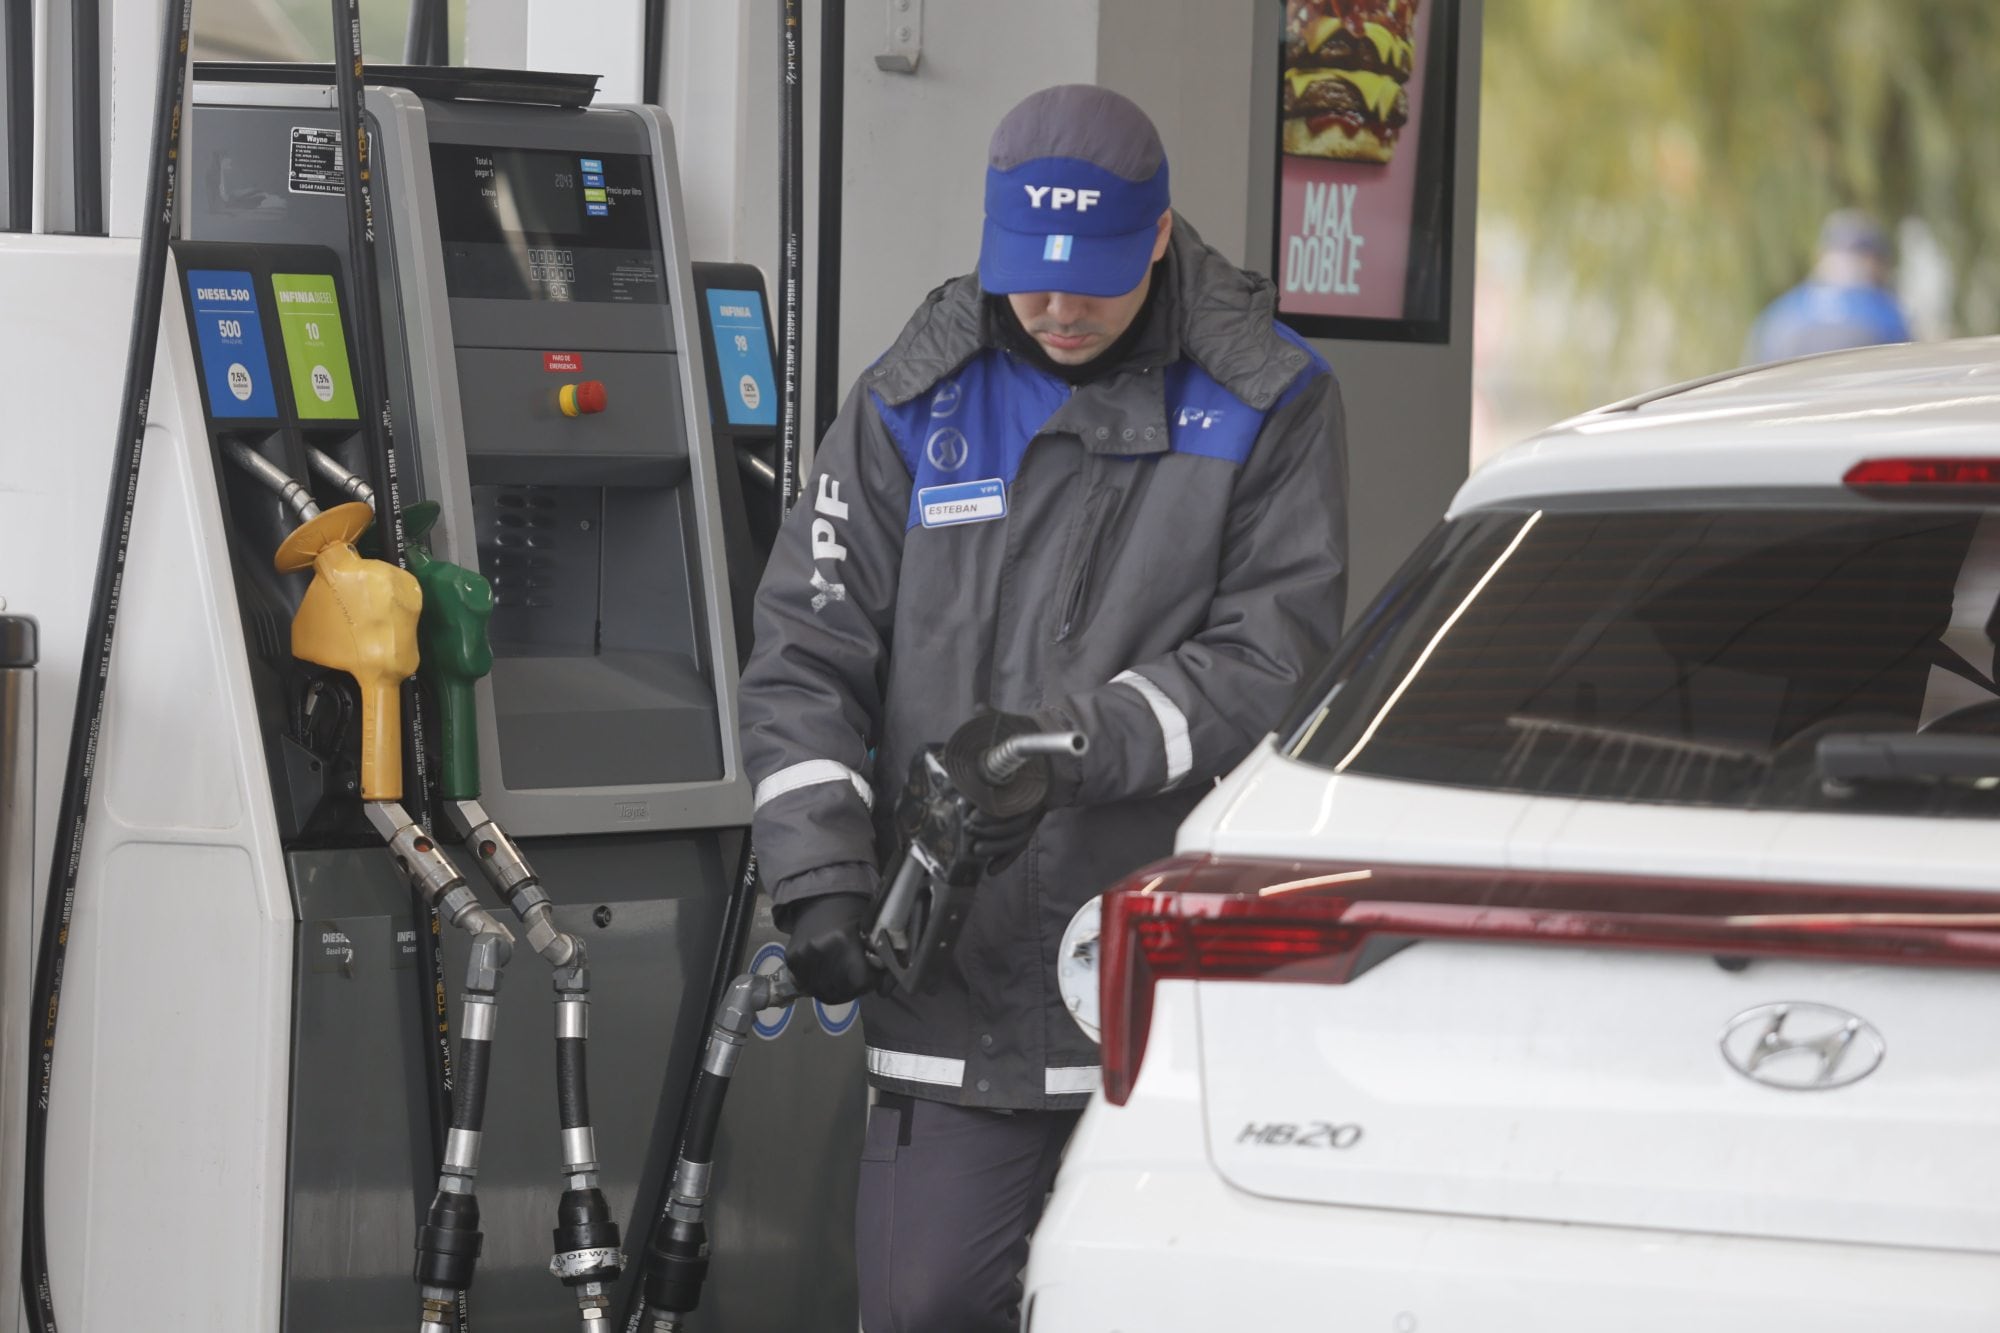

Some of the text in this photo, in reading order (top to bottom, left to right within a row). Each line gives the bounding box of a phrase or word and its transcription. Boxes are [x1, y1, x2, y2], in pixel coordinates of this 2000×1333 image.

[307, 135, 328, 144] Wayne
[1024, 184, 1101, 212] YPF
[1304, 181, 1357, 238] MAX
[1286, 235, 1364, 295] DOBLE
[218, 320, 241, 338] 500
[305, 322, 320, 340] 10
[1173, 406, 1224, 429] PF
[928, 504, 978, 515] ESTEBAN
[810, 473, 849, 613] YPF
[118, 549, 126, 562] WP
[1235, 1120, 1363, 1150] HB20
[567, 1250, 602, 1260] OPW
